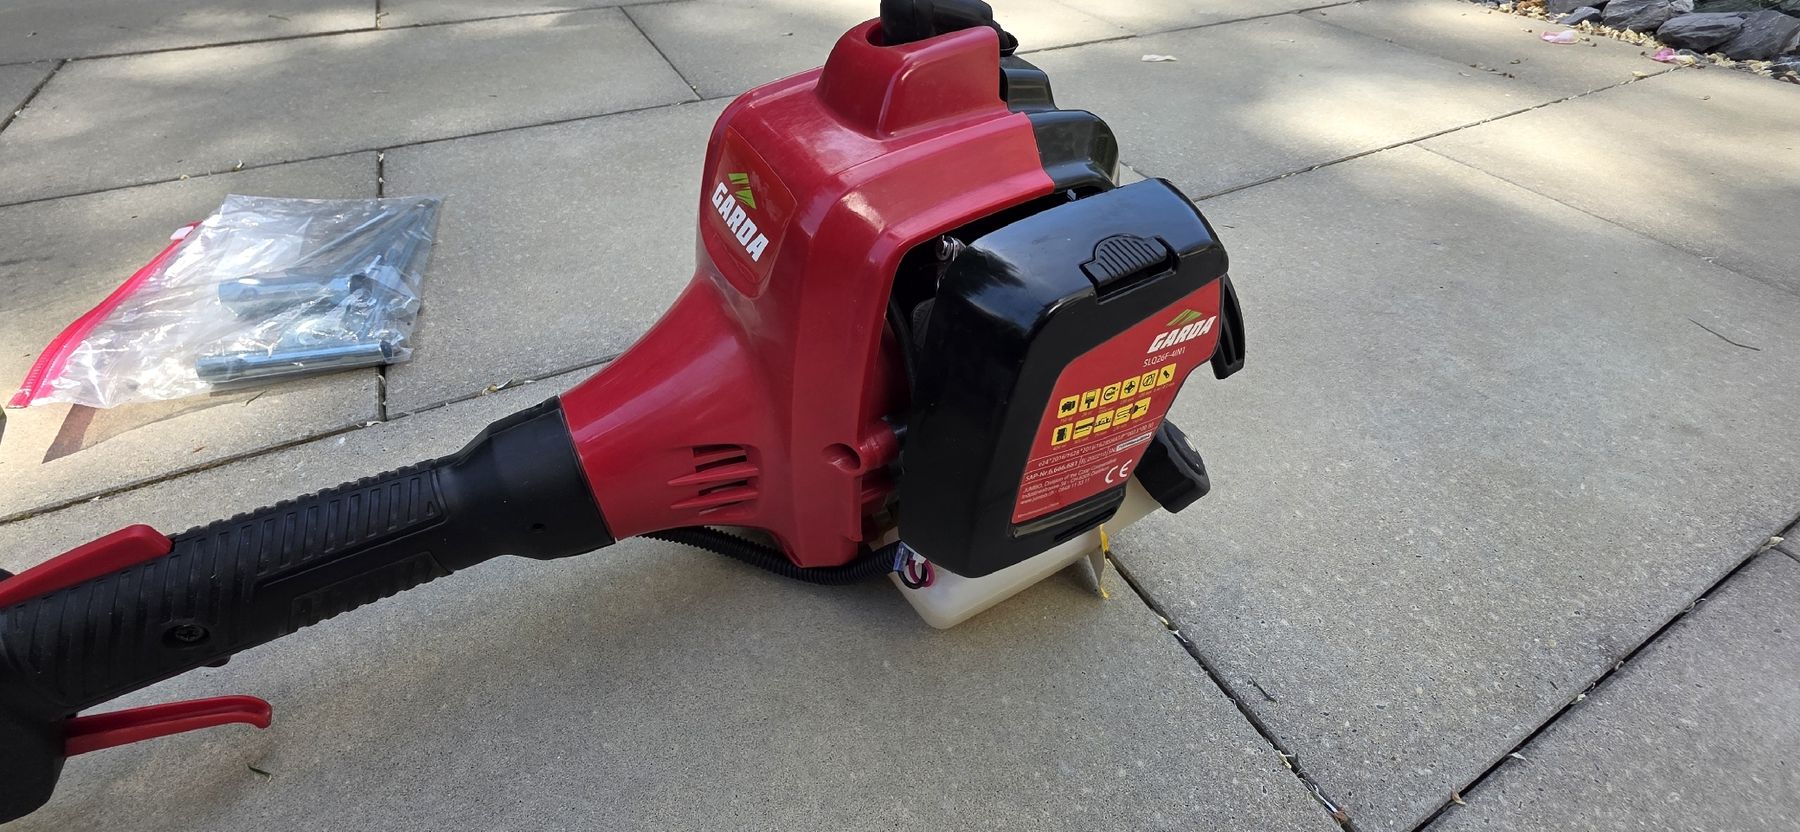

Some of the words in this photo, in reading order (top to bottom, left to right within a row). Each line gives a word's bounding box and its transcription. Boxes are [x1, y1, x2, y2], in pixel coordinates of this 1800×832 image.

[712, 181, 769, 262] GARDA
[1146, 315, 1217, 354] GARDA
[1142, 347, 1186, 367] SLQ26F-4IN1
[1105, 459, 1132, 483] CE
